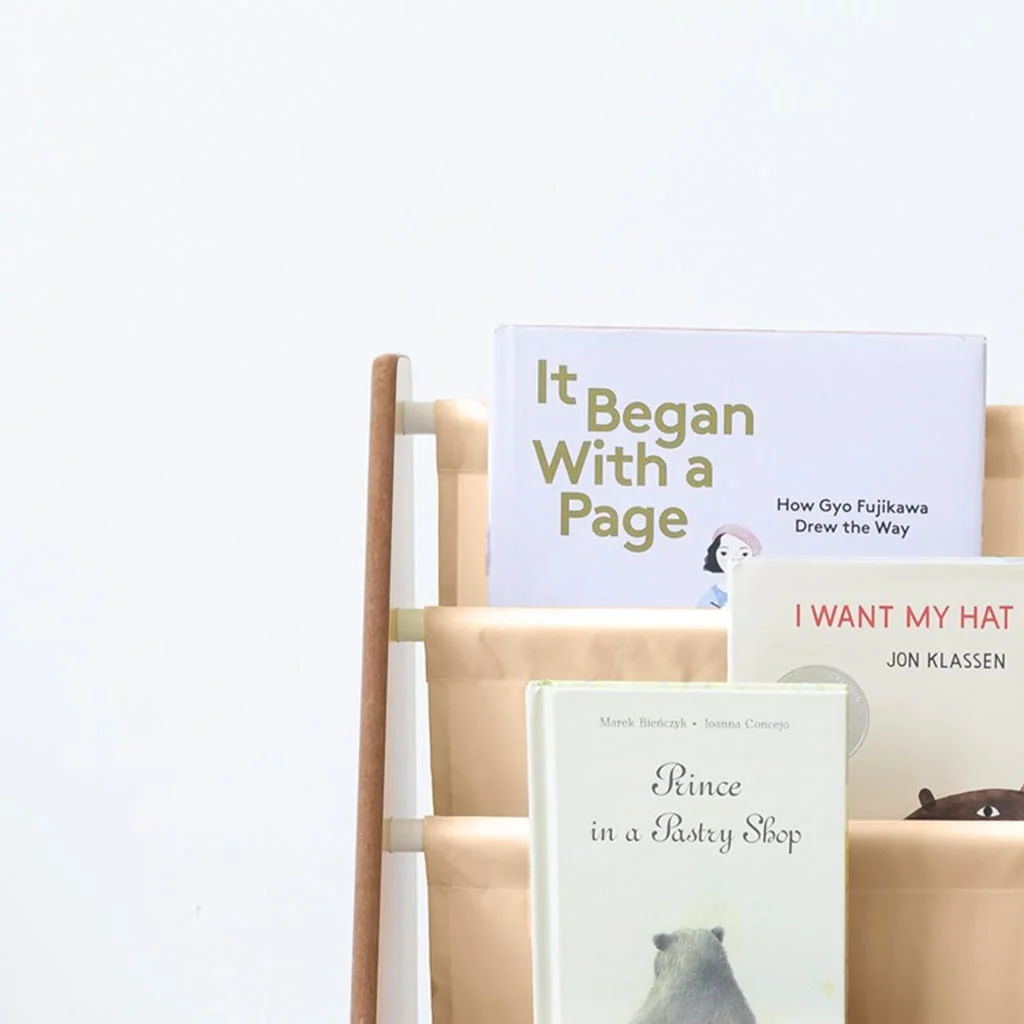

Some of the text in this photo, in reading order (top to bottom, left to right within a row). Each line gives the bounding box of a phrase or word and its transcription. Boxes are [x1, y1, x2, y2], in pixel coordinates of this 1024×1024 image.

[538, 360, 754, 449] It Began
[532, 438, 713, 488] With a
[560, 492, 688, 553] Page
[778, 498, 928, 517] How Gyo Fujikawa
[796, 519, 909, 538] Drew the Way
[794, 603, 802, 628] I
[811, 605, 893, 628] WANT
[907, 606, 949, 628] MY
[961, 606, 1013, 629] HAT
[887, 652, 1005, 669] JON KLASSEN
[599, 716, 635, 728] Marek
[704, 718, 741, 729] Joanna
[744, 718, 790, 732] Concejo
[651, 762, 742, 797] Prince
[591, 812, 802, 855] in a Pastry Shop
